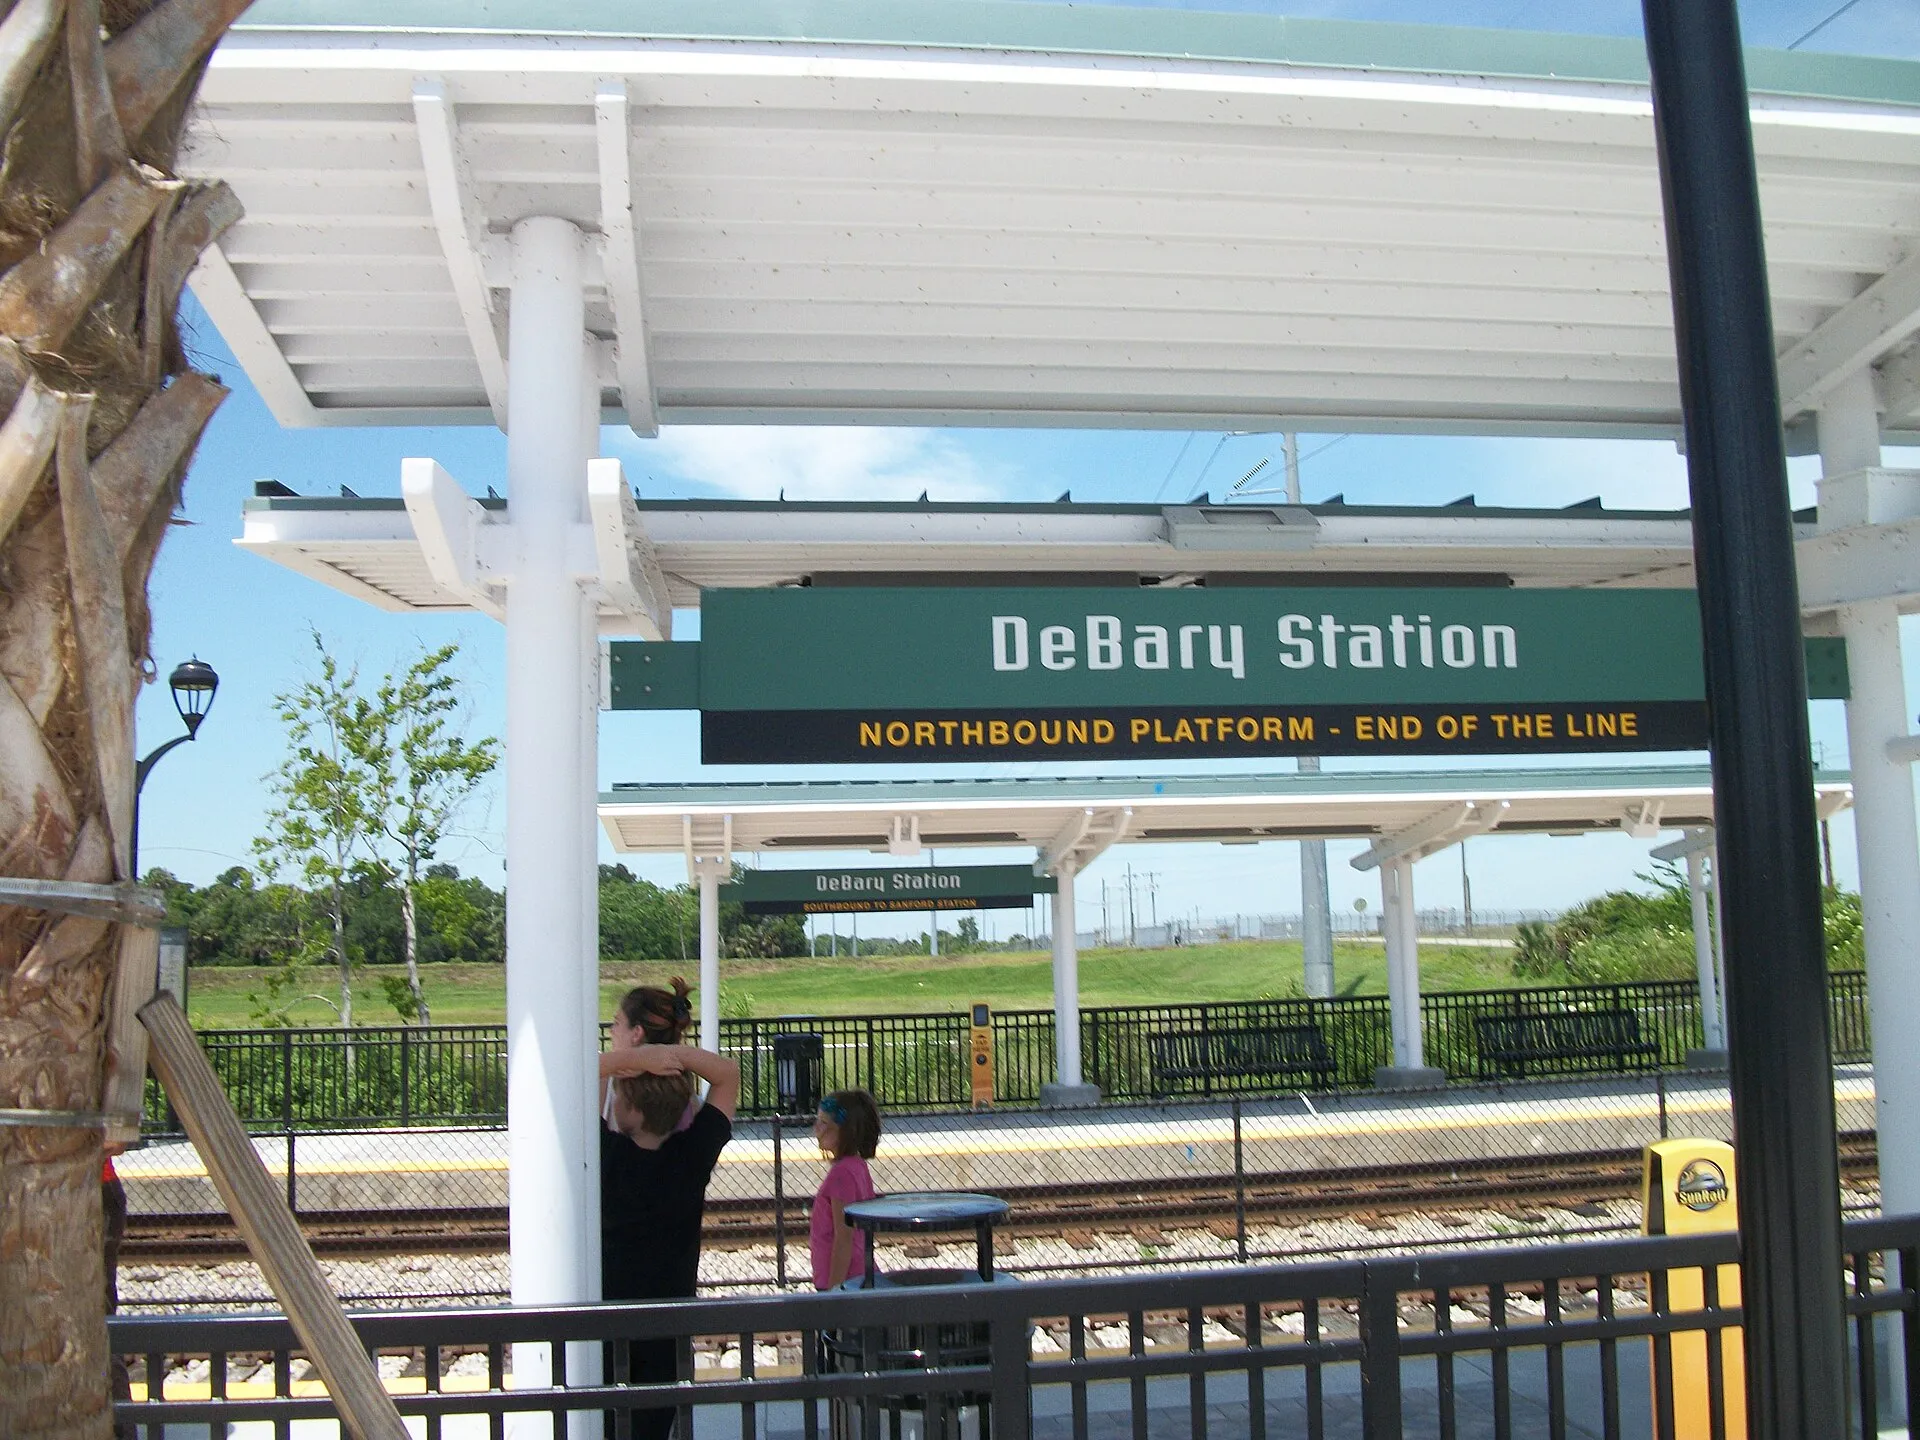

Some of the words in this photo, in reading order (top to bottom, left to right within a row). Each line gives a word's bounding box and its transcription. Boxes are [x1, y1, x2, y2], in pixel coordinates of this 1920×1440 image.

[991, 615, 1245, 679] DeBary
[1277, 614, 1517, 669] Station
[860, 719, 1115, 746] NORTHBOUND
[1131, 716, 1314, 743] PLATFORM
[1355, 716, 1422, 740] END
[1436, 715, 1478, 739] OF
[1491, 714, 1553, 738] THE
[1567, 712, 1638, 737] LINE
[816, 873, 885, 893] DeBary
[892, 871, 961, 890] Station
[803, 901, 871, 912] SOUTHBOUND
[874, 901, 887, 910] TO
[889, 900, 935, 909] SANFORD
[937, 898, 977, 909] STATION
[1679, 1189, 1726, 1205] SunRail
